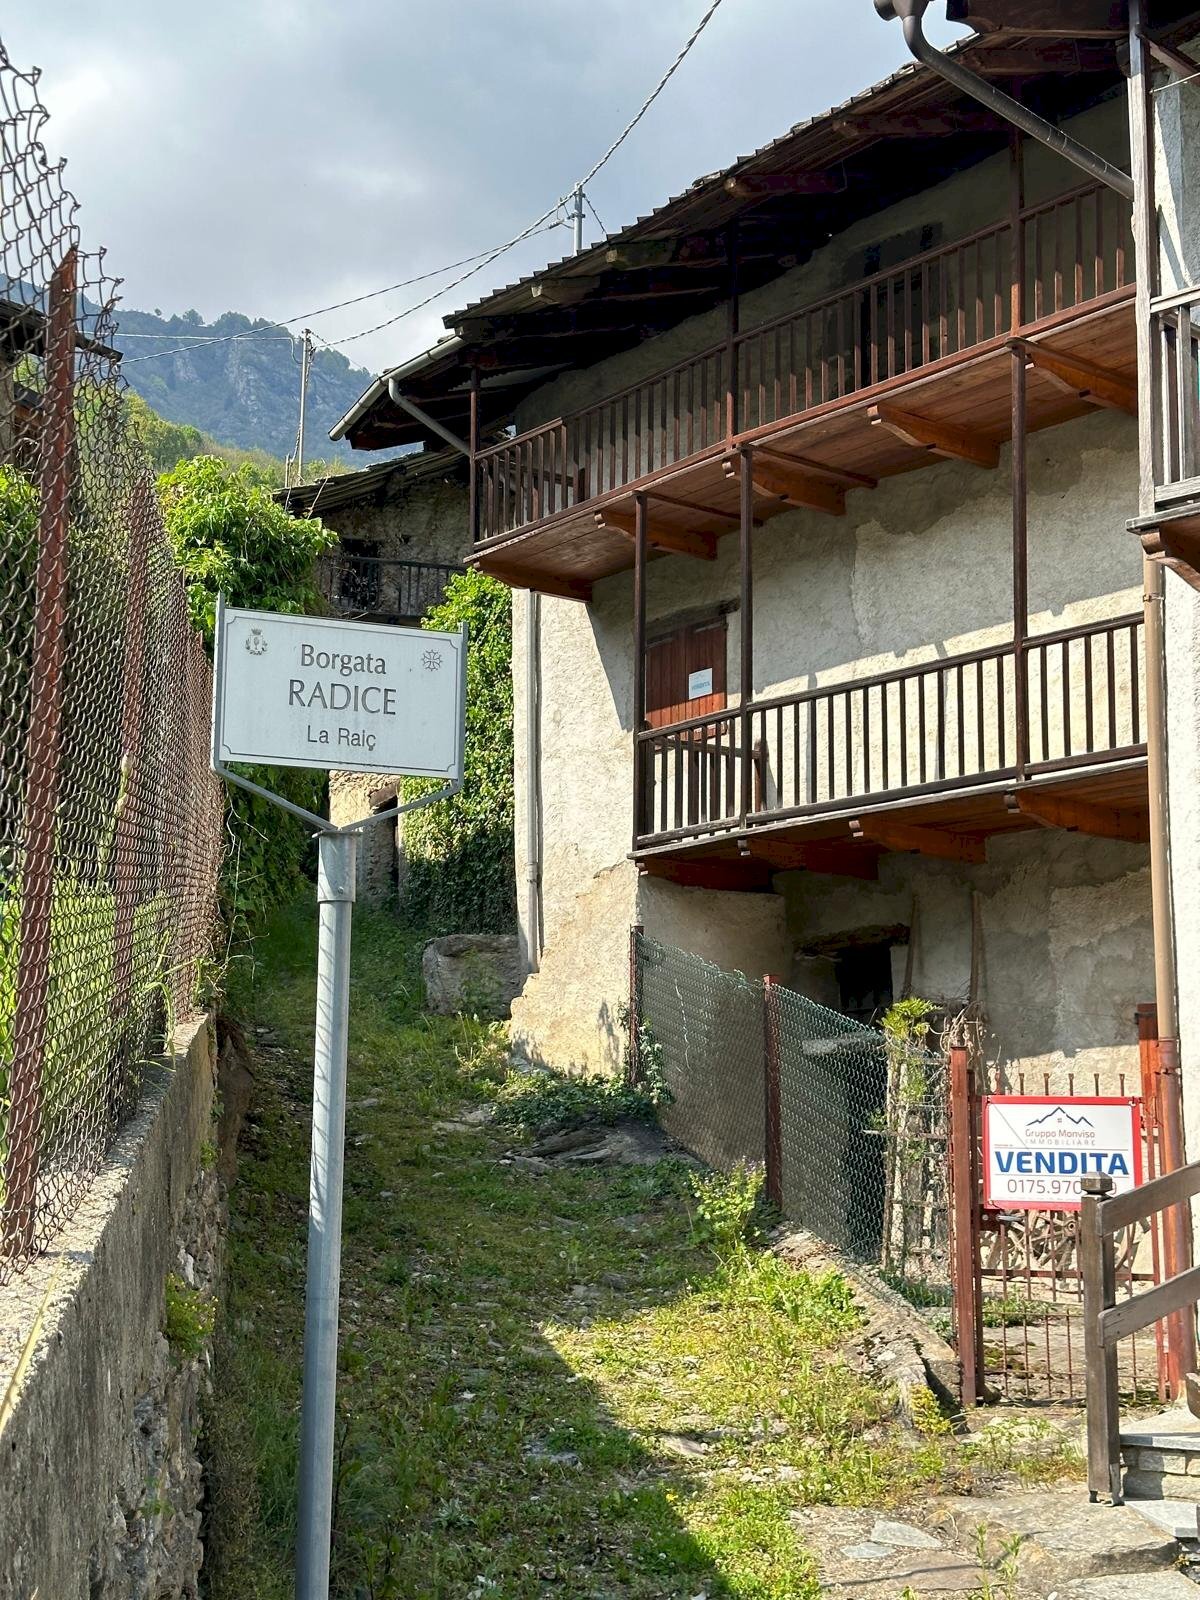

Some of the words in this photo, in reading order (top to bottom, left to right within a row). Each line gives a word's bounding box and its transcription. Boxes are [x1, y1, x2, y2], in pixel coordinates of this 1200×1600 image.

[300, 643, 387, 676] Borgata
[288, 679, 397, 715] RADICE
[307, 725, 329, 744] La
[338, 727, 376, 750] Raiç
[1025, 1129, 1056, 1138] Gruppo
[1058, 1129, 1095, 1138] Monviso
[994, 1151, 1129, 1175] VENDITA
